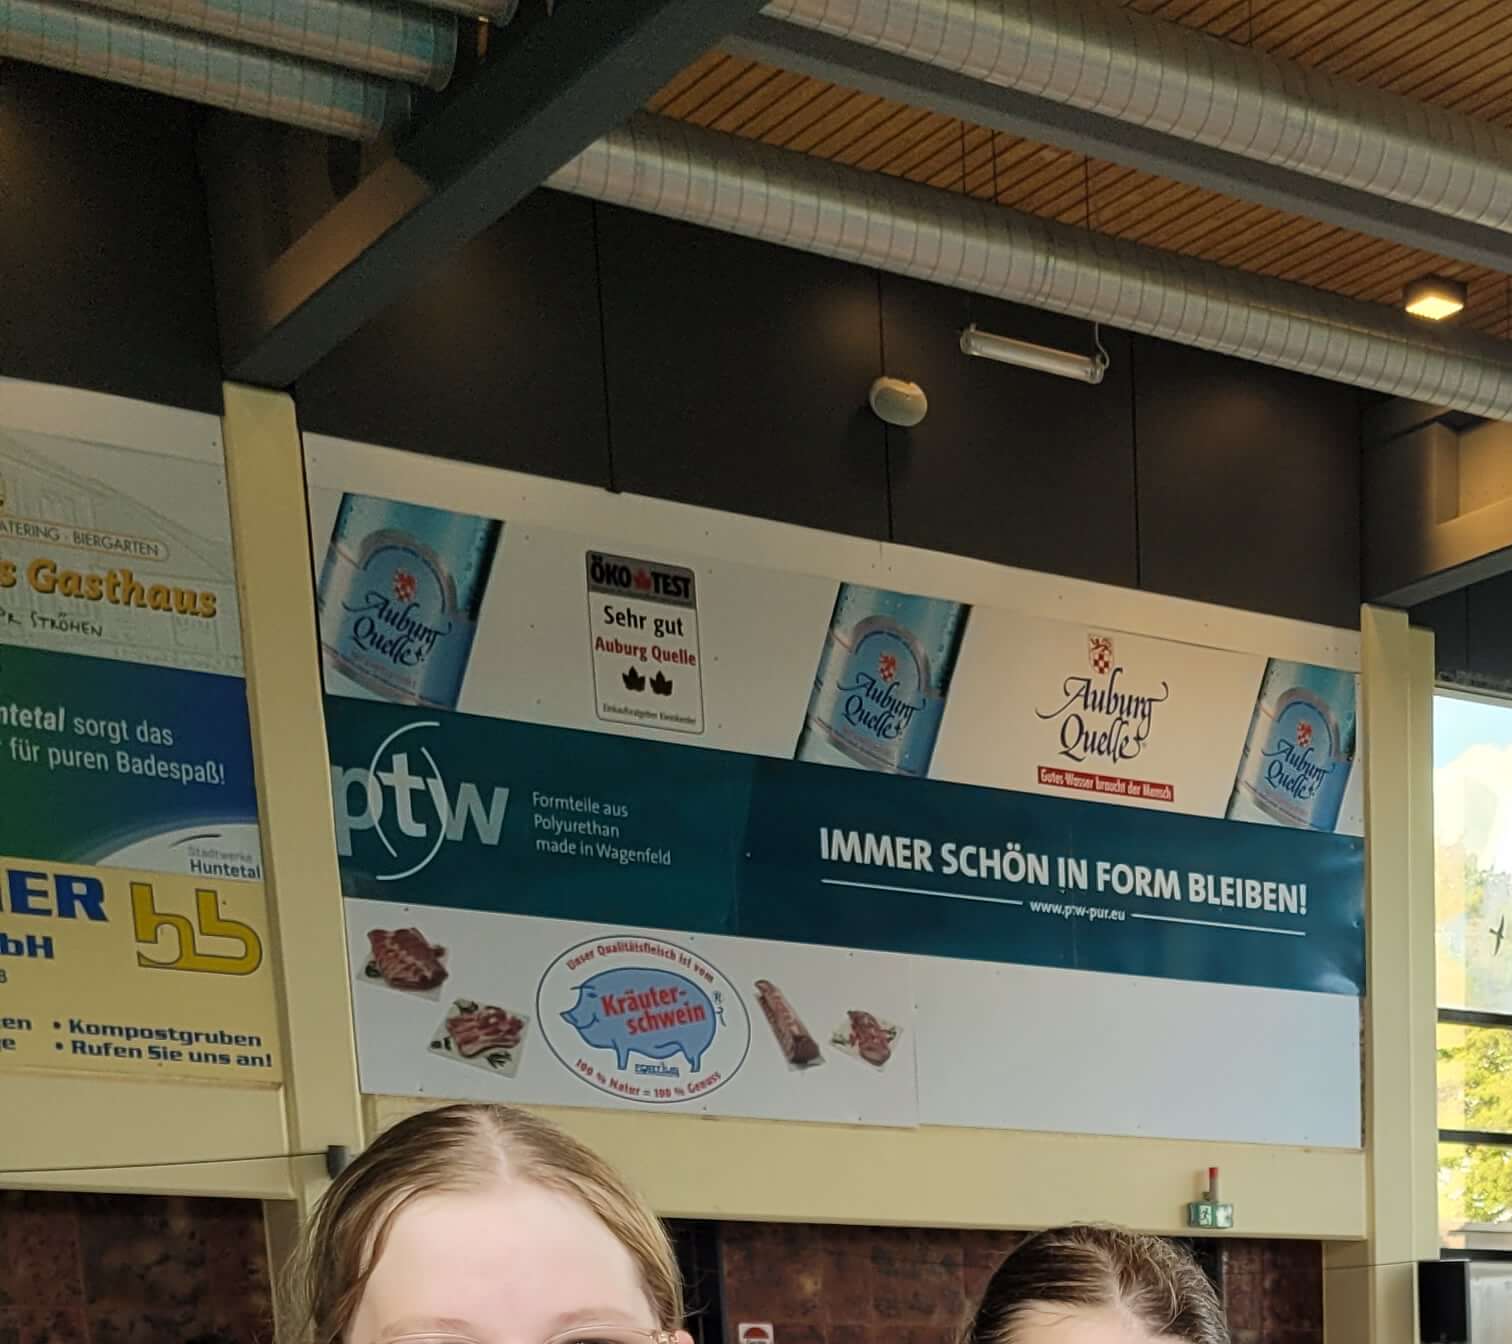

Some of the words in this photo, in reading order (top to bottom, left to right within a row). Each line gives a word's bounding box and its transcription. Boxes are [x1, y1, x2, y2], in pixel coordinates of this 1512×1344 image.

[73, 531, 160, 556] BIERGARTEN
[27, 557, 217, 618] Gasthaus
[591, 554, 632, 588] ÖKO
[651, 571, 691, 599] TEST
[30, 610, 103, 637] STRÖHEN
[342, 589, 452, 655] Auburg
[352, 616, 421, 667] Quelle
[603, 605, 647, 630] Sehr
[654, 616, 684, 638] gut
[595, 636, 648, 662] Auburg
[651, 645, 697, 666] Quelle
[837, 671, 927, 728] Auburg
[842, 694, 902, 739] Quelle
[1034, 667, 1169, 740] Auburg
[73, 716, 130, 744] sorgt
[136, 719, 174, 746] das
[1057, 713, 1141, 764] Quelle
[10, 737, 40, 763] für
[47, 746, 109, 771] puren
[116, 750, 226, 785] Badespaß!
[1261, 738, 1337, 790] Auburg
[1264, 759, 1316, 800] Quelle
[330, 752, 510, 857] ptw
[532, 791, 600, 815] Formteile
[602, 801, 629, 817] aus
[533, 814, 620, 839] Polyurethan
[190, 858, 262, 880] Huntetal
[536, 838, 577, 856] made
[580, 842, 594, 857] in
[596, 844, 672, 866] Wagenfeld
[819, 826, 934, 872] IMMER
[941, 841, 1050, 886] SCHÖN
[1057, 856, 1088, 891] IN
[1097, 860, 1182, 901] FORM
[1188, 872, 1308, 915] BLEIBEN!
[0, 869, 109, 922] ER
[566, 950, 594, 970] Unser
[597, 941, 676, 960] Qualitätsfleisch
[679, 954, 692, 968] ist
[694, 963, 714, 983] vom
[600, 986, 688, 1017] Kräuter-
[626, 1001, 706, 1036] schwein
[69, 1018, 262, 1047] Kompostgruben
[71, 1039, 143, 1060] Rufen
[148, 1044, 183, 1062] Sie
[189, 1050, 231, 1066] uns
[236, 1052, 273, 1068] an!
[609, 1077, 641, 1096] Natur
[654, 1088, 672, 1098] 100
